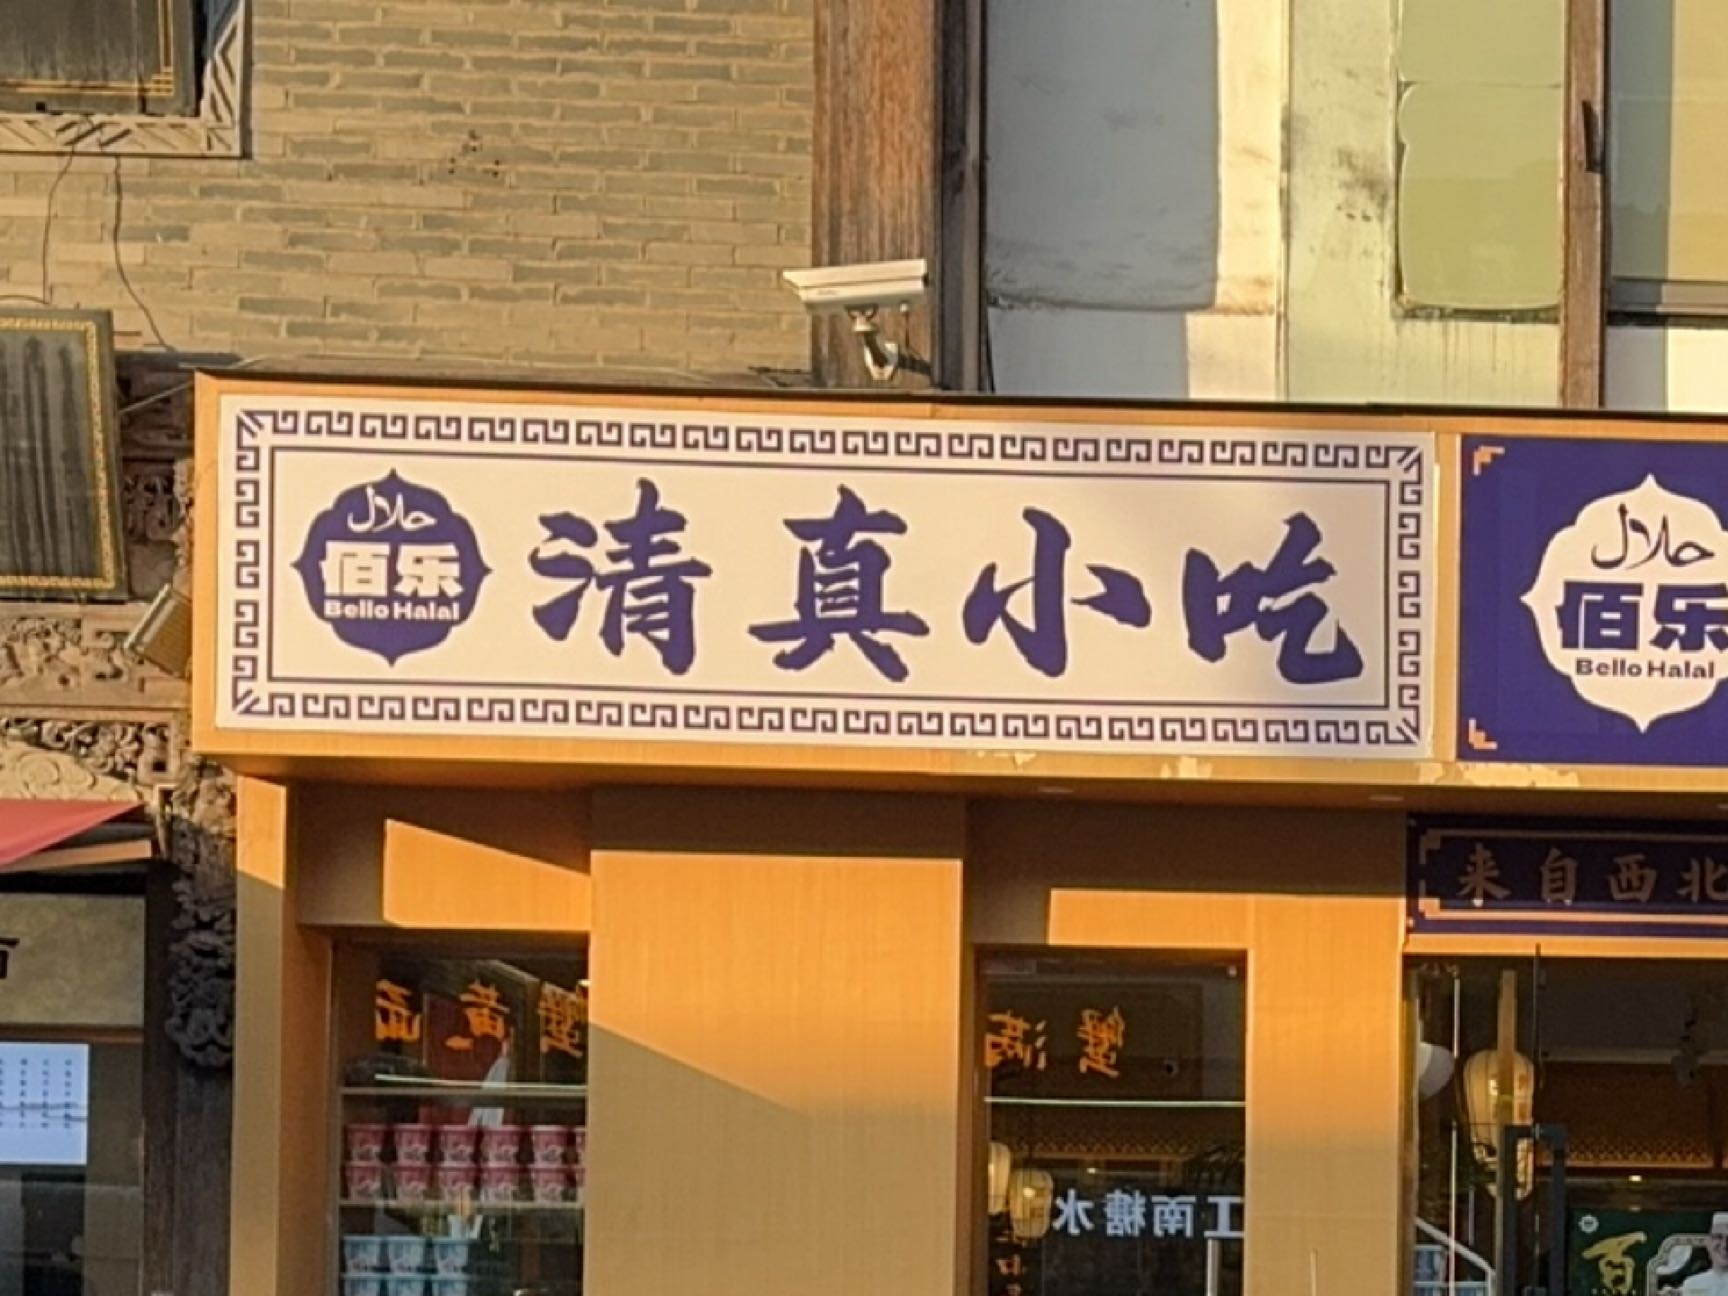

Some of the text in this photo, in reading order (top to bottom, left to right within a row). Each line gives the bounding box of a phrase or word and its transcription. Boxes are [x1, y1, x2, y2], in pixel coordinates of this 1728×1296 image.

[319, 541, 465, 598] 佰乐
[527, 478, 1366, 686] 清真小吃
[324, 599, 460, 621] Bello Halal
[1575, 657, 1715, 679] Bello Halal
